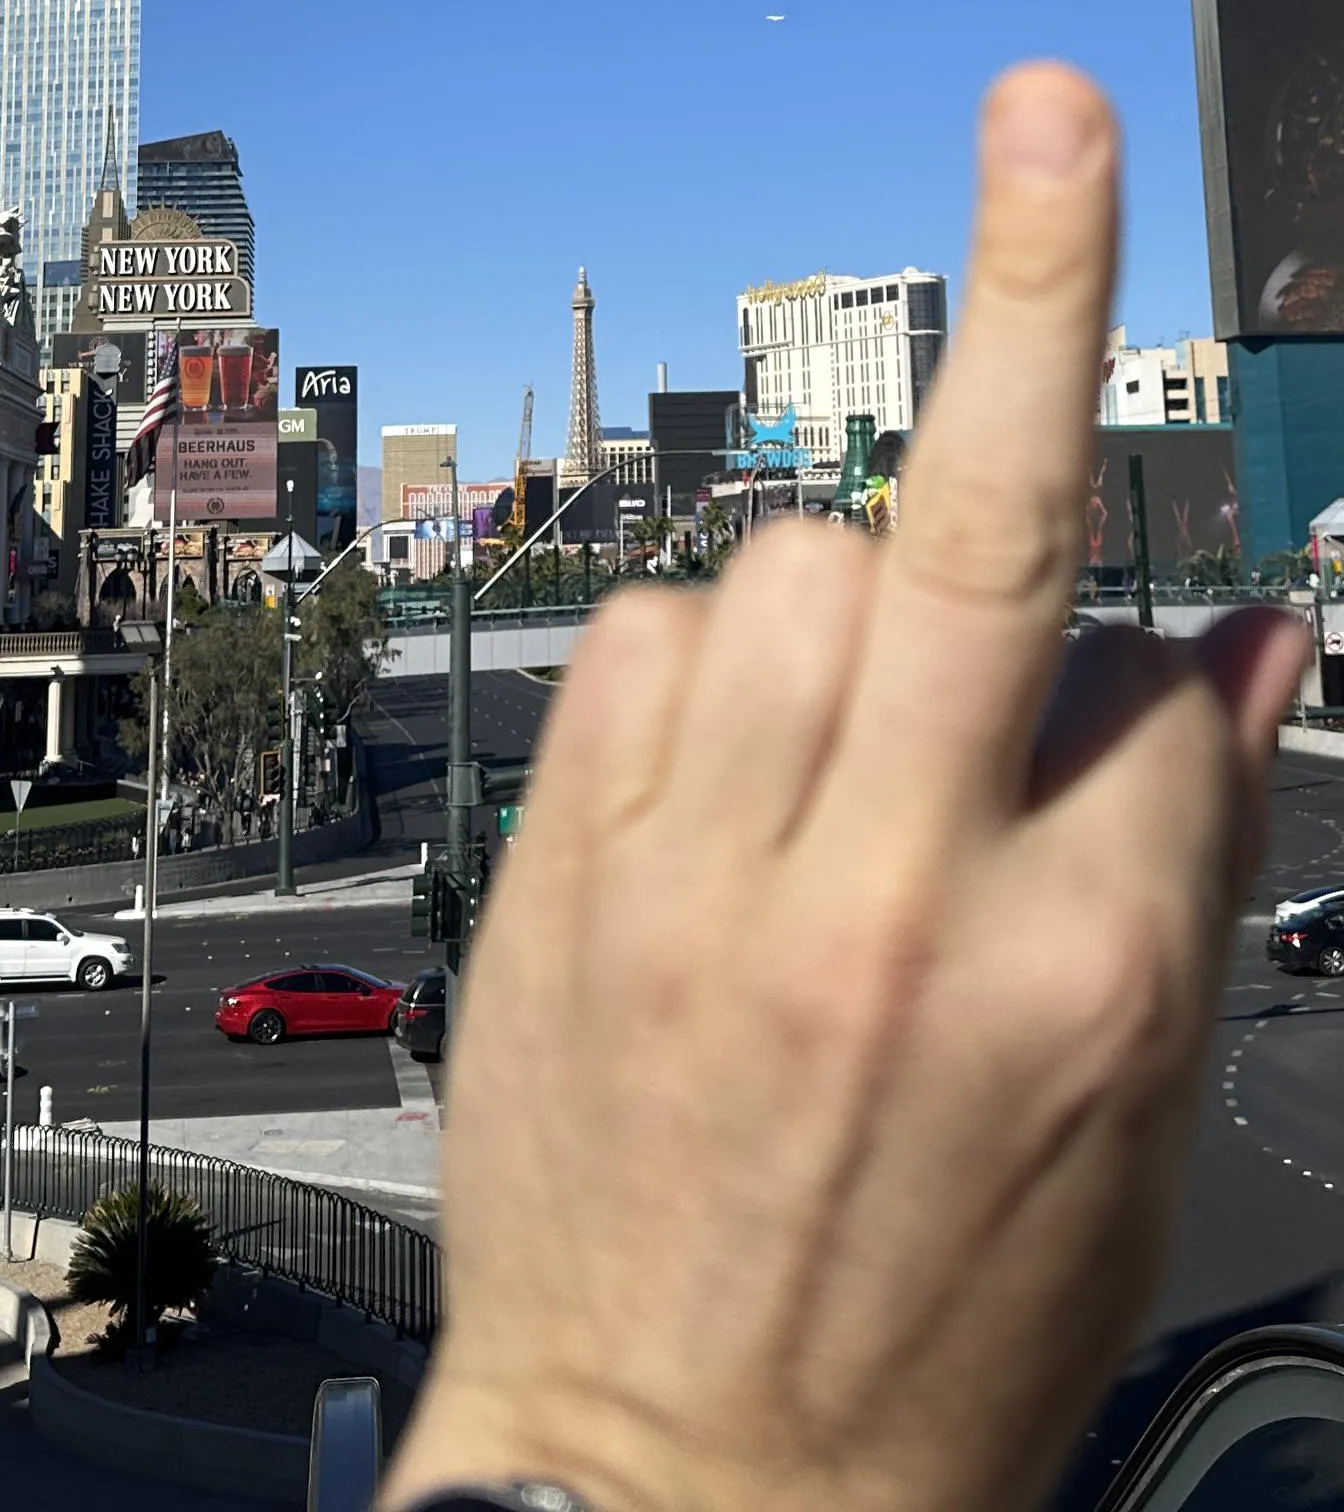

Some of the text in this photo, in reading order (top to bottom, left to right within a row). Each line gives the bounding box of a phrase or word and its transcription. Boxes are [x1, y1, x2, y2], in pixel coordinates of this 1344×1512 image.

[100, 245, 232, 275] NEW YORK
[98, 282, 232, 313] NEW YORK
[301, 370, 351, 398] Aria
[278, 419, 305, 433] GM
[404, 426, 436, 435] TRUMP
[178, 439, 256, 454] BEERHAUS
[90, 390, 113, 530] HAKE SHACK
[183, 458, 219, 470] HANG
[737, 449, 812, 469] BRWDOG
[179, 470, 211, 482] HAVE
[213, 470, 222, 480] A
